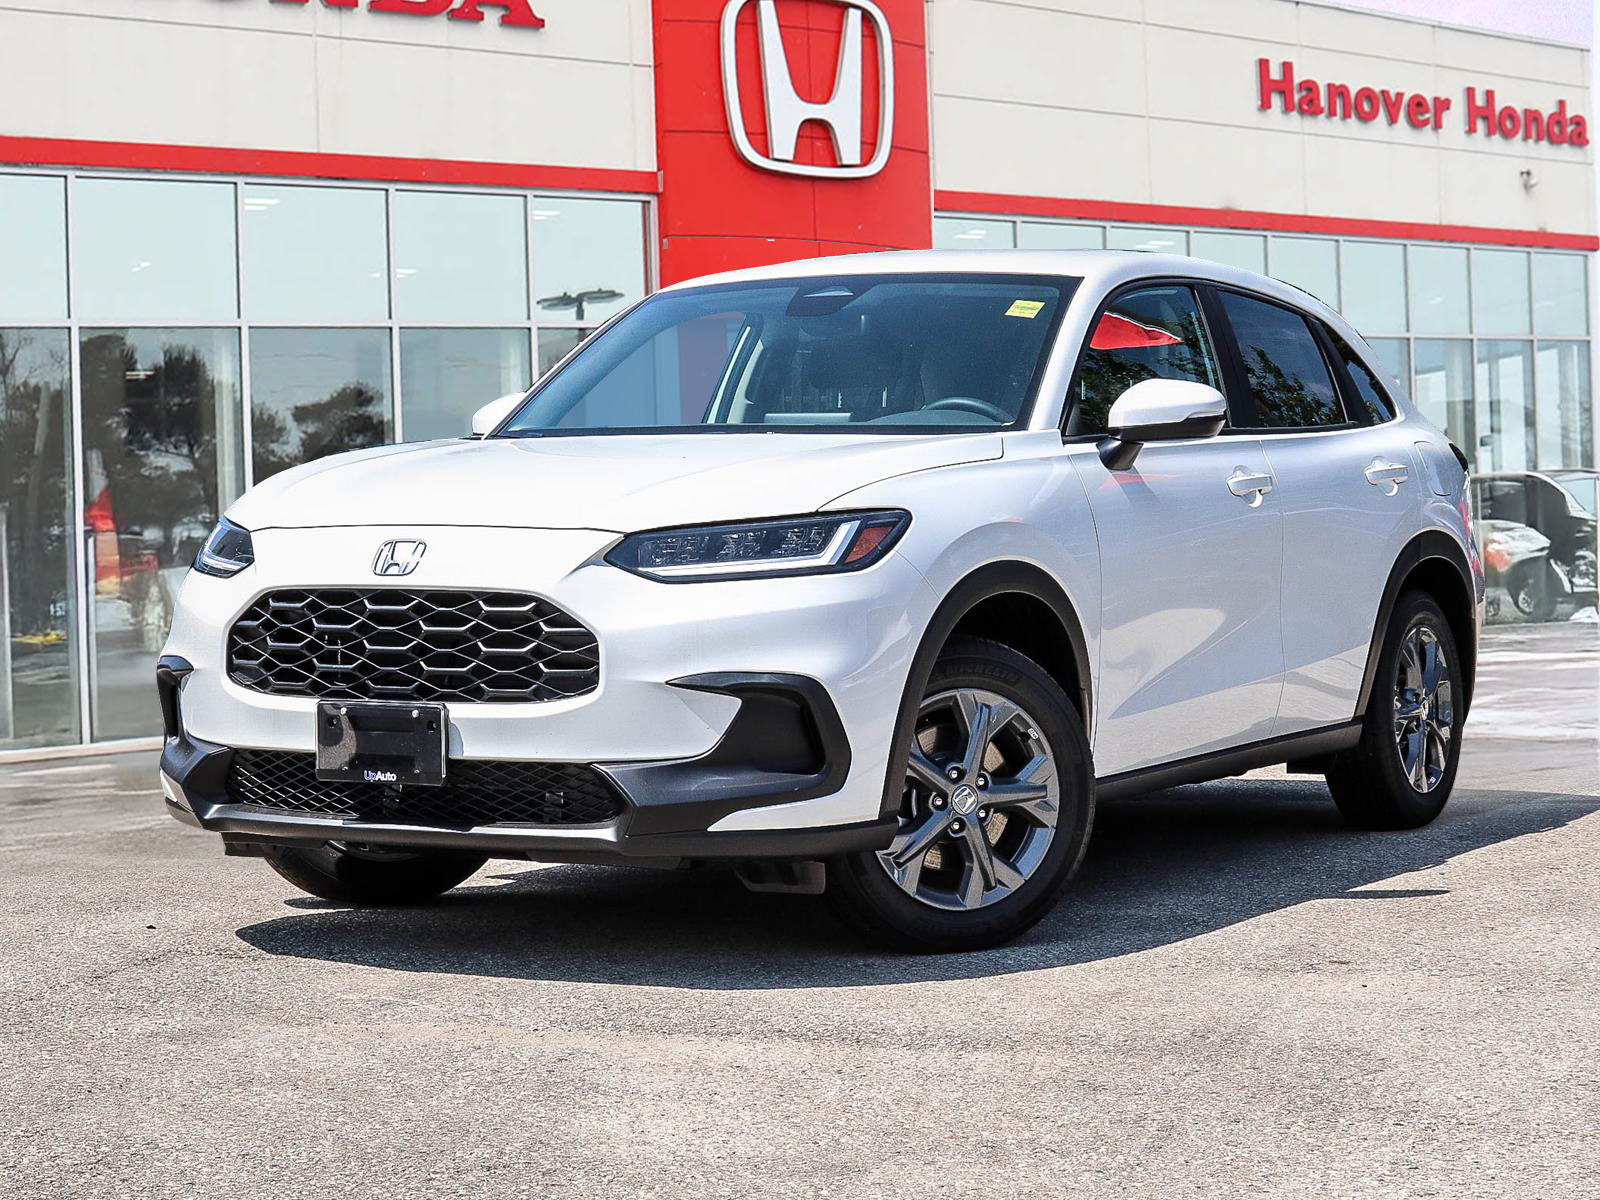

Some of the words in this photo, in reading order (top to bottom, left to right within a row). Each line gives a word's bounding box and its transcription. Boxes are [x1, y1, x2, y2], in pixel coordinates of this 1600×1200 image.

[1257, 57, 1452, 130] Hanover
[1465, 86, 1590, 148] Honda
[363, 770, 397, 782] UpAuto
